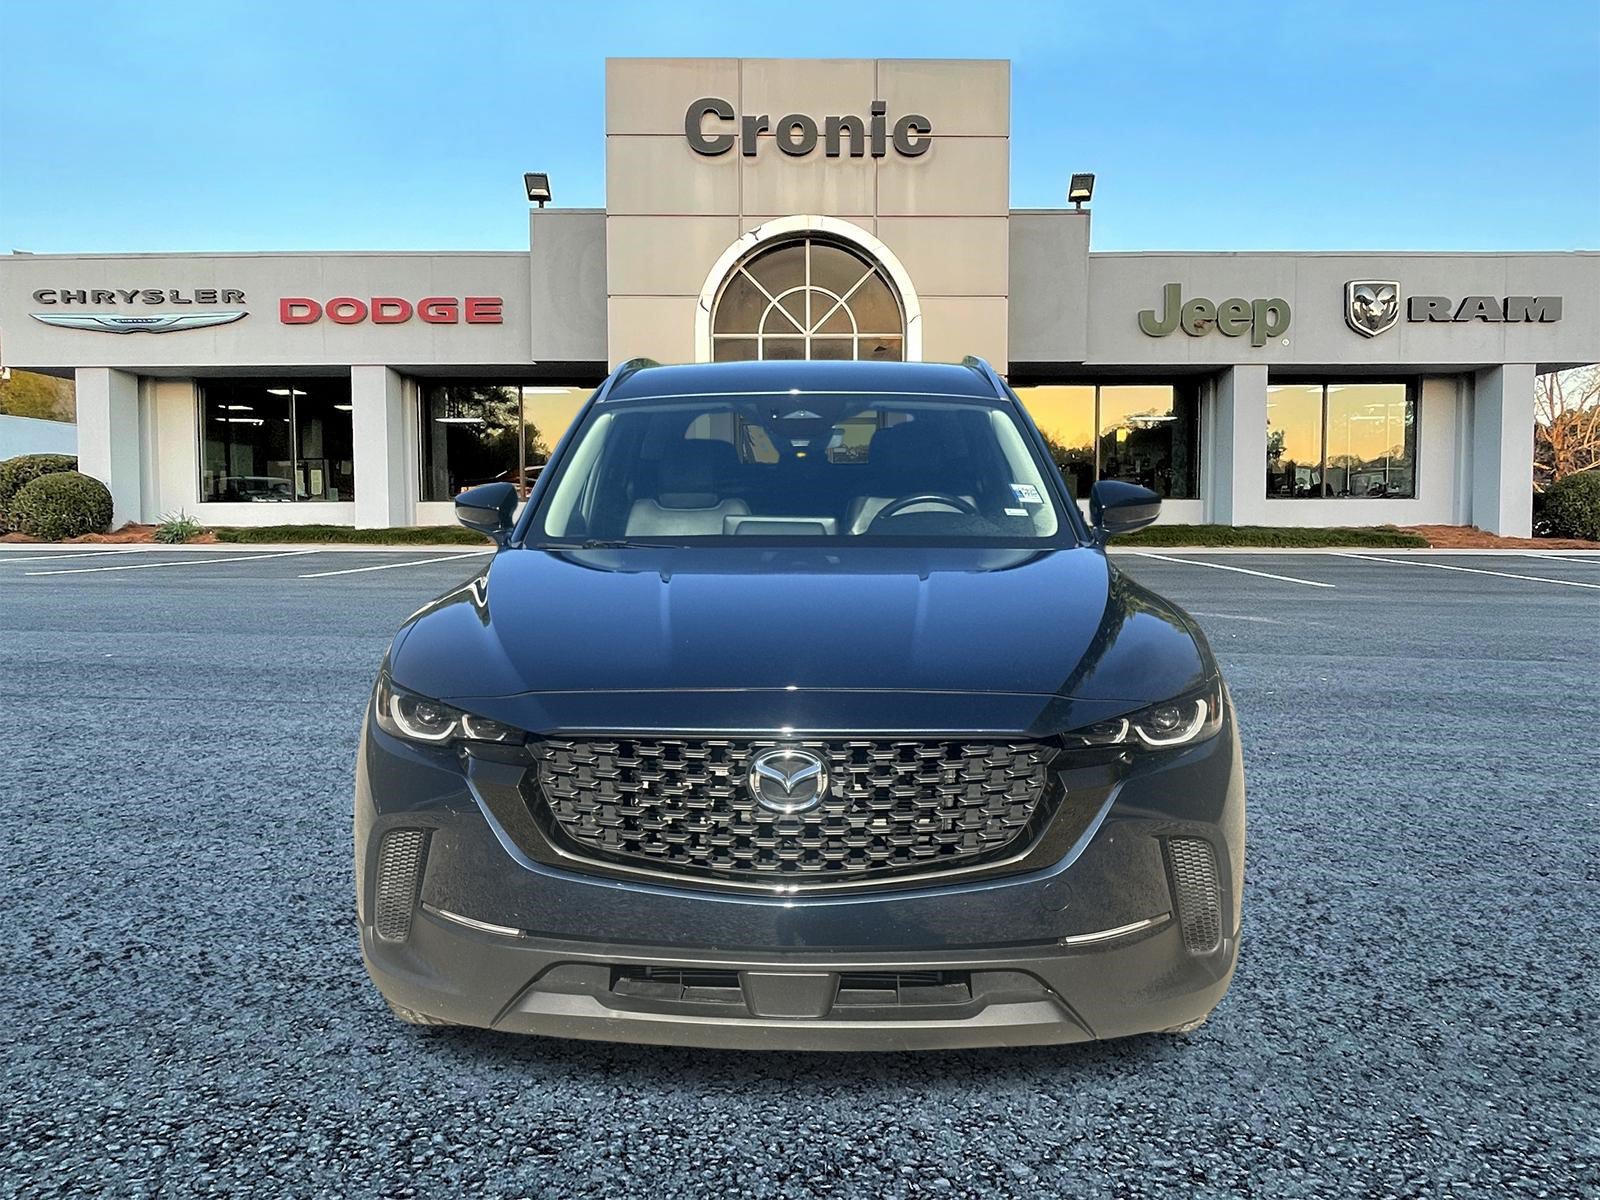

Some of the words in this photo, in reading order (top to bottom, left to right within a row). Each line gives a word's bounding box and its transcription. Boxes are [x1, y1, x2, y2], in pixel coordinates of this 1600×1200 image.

[685, 97, 932, 157] Cronic
[32, 288, 247, 304] CHRYSLER
[279, 296, 505, 325] DODGE
[1407, 296, 1563, 323] RAM
[1138, 283, 1292, 347] Jeep
